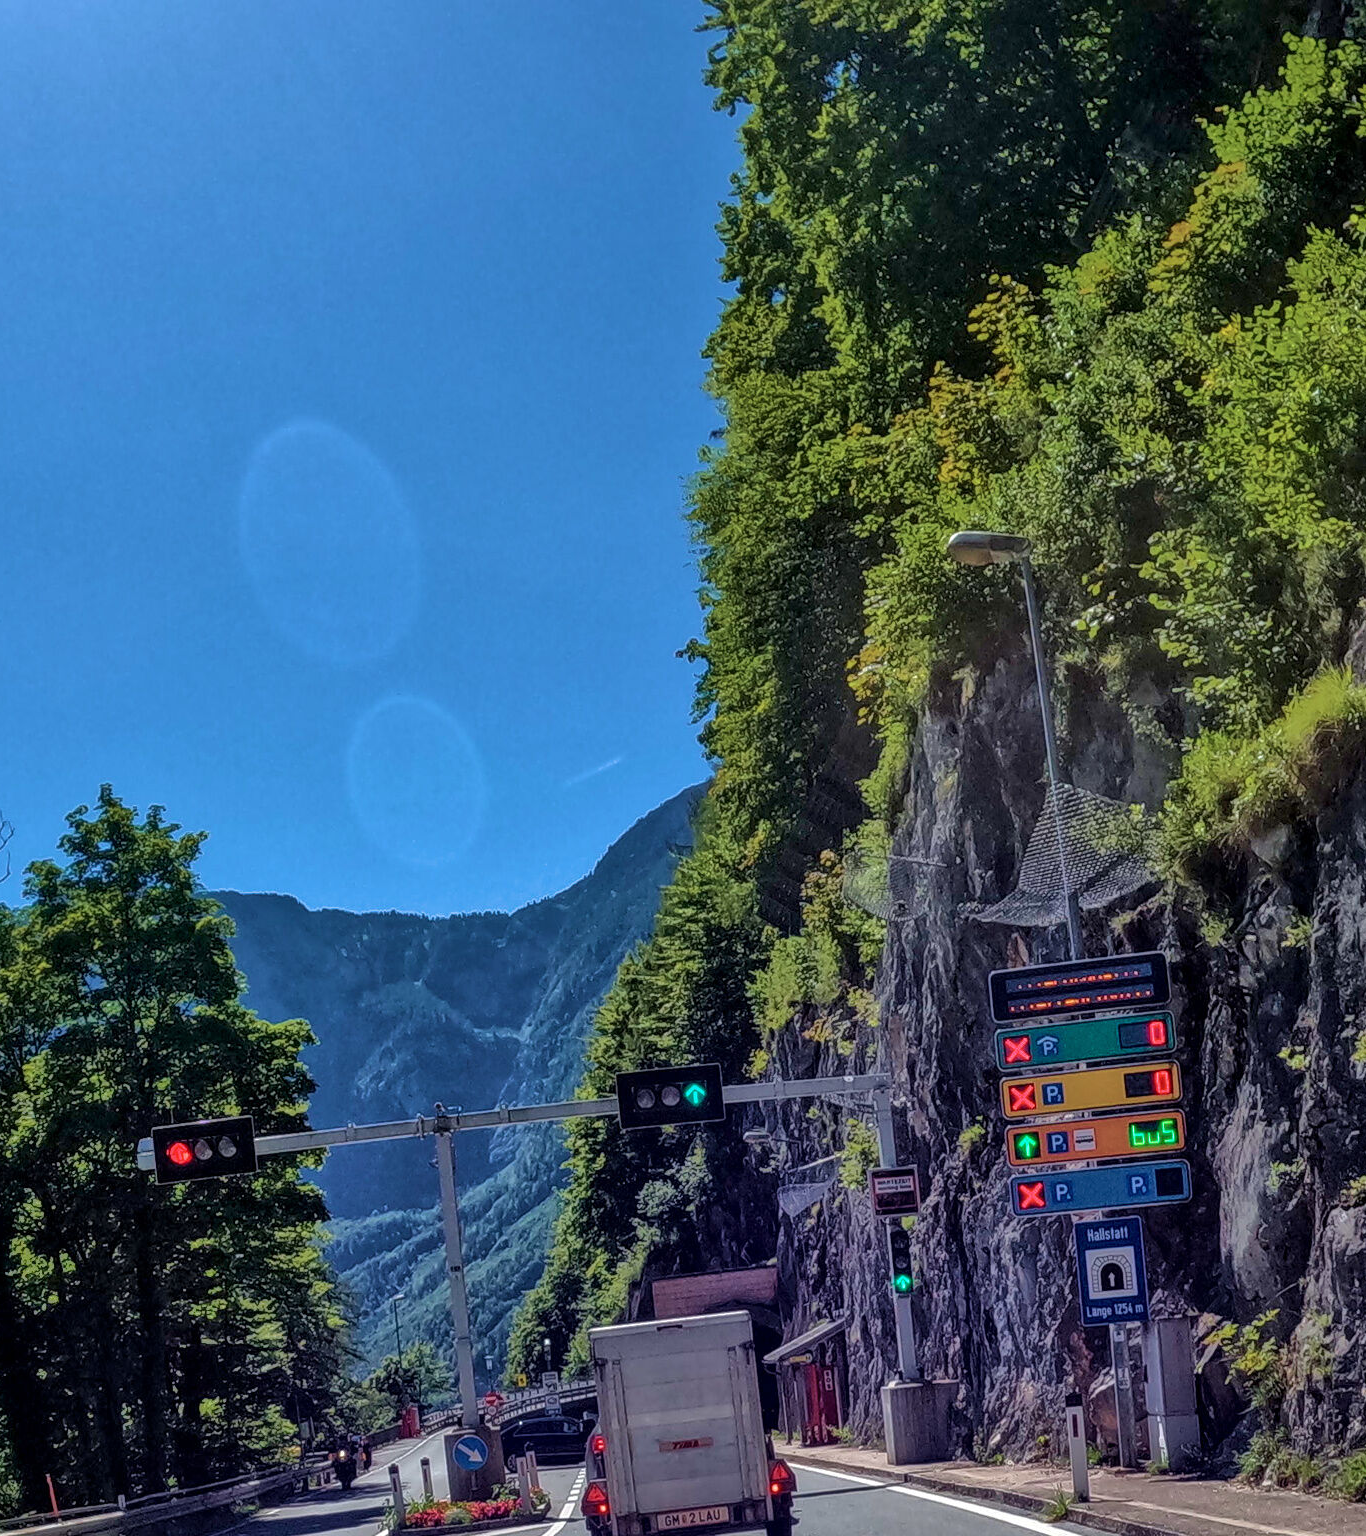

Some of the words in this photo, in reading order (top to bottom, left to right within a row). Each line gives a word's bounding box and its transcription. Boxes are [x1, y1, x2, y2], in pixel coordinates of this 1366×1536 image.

[1150, 1021, 1166, 1046] 0
[1155, 1070, 1172, 1095] 0
[1087, 1226, 1129, 1242] Hallstatt
[1114, 1302, 1134, 1315] 1254
[1135, 1303, 1144, 1314] m
[664, 1514, 680, 1527] GM
